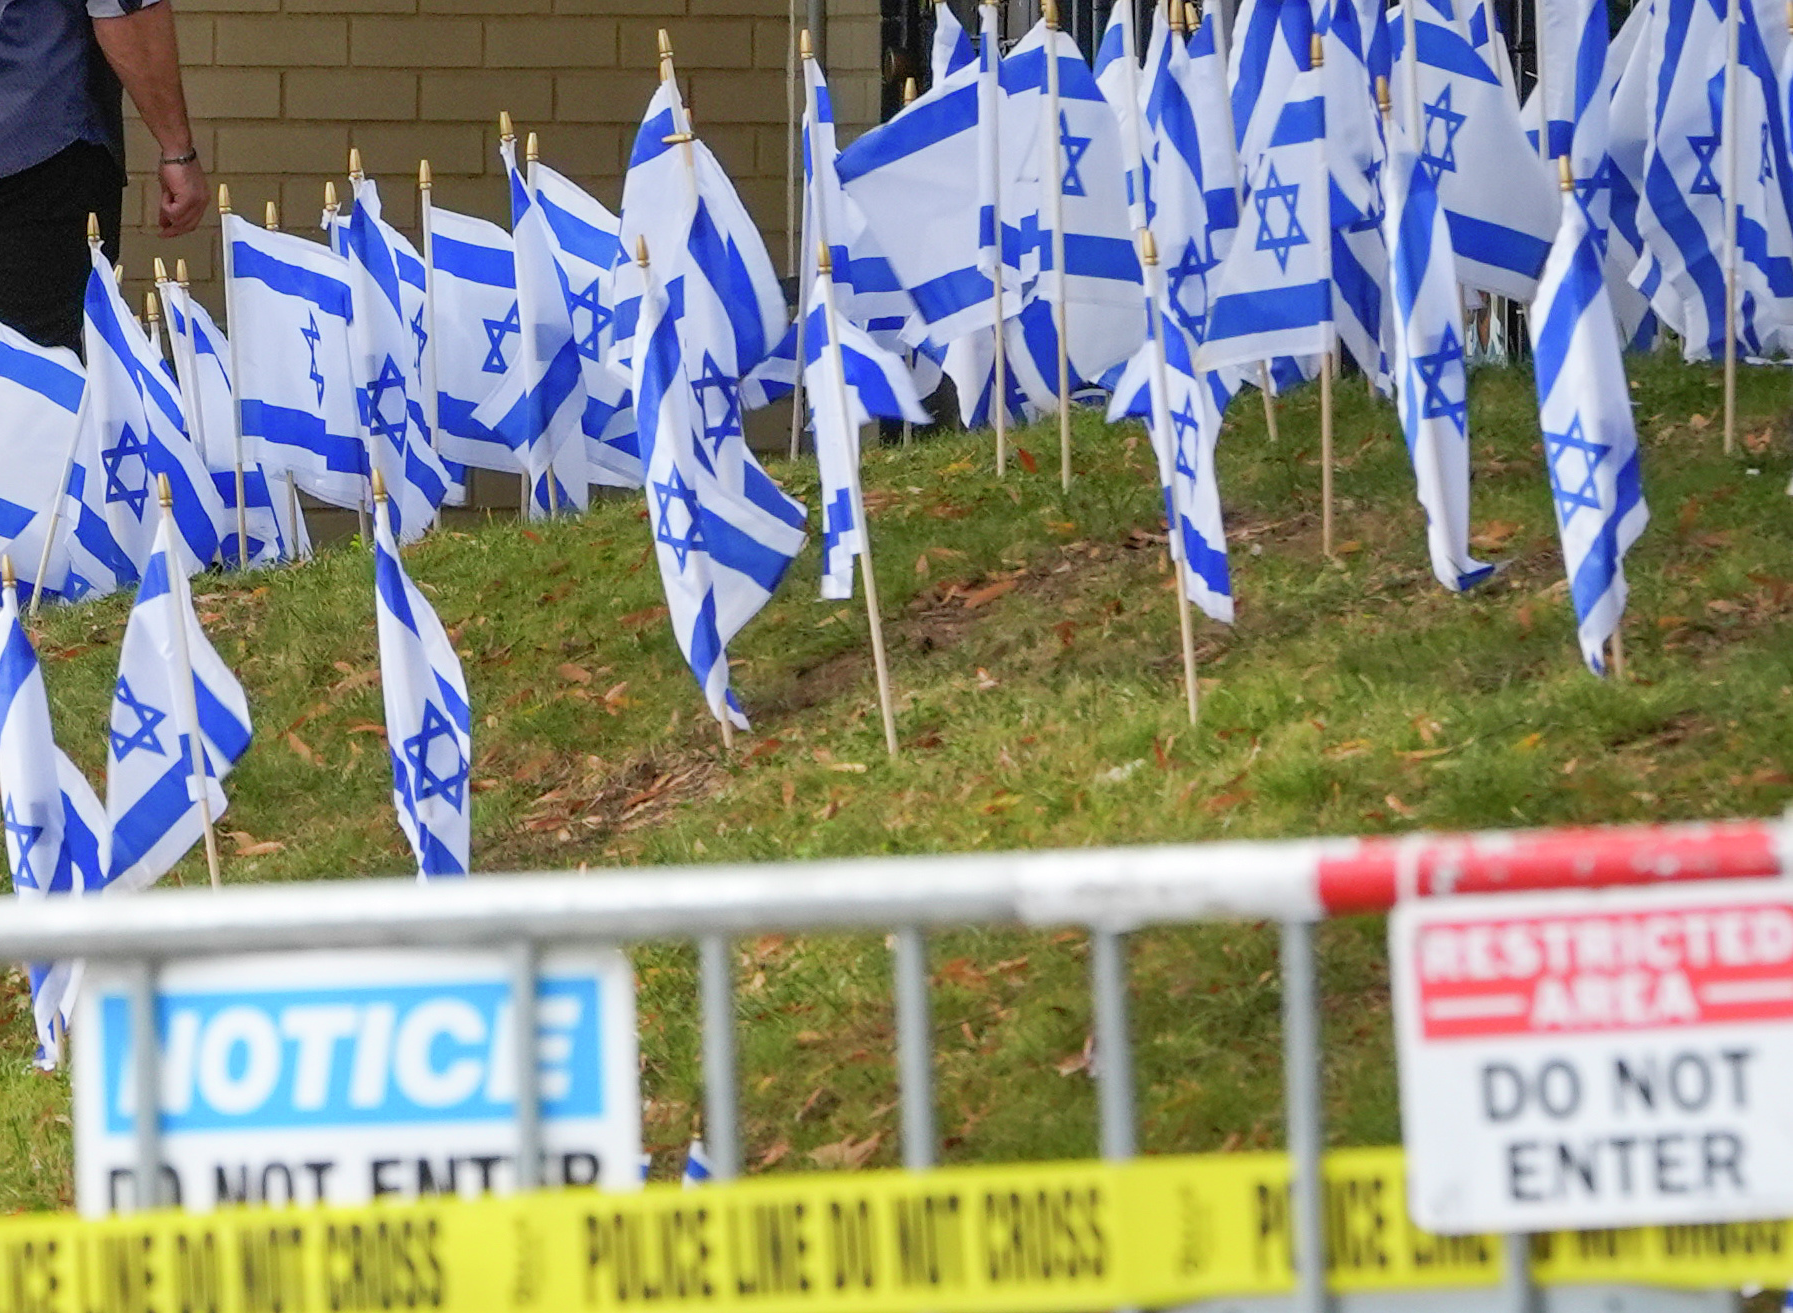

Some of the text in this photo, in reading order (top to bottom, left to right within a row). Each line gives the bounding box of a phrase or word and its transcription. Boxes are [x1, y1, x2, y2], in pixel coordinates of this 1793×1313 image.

[1419, 908, 1793, 984] RESTRICTED
[1530, 967, 1702, 1032] AREA
[116, 994, 585, 1118] NOTICE
[1480, 1046, 1752, 1123] DO NOT
[1506, 1130, 1746, 1202] ENTER
[582, 1205, 712, 1303] POLICE
[724, 1200, 814, 1295] LINE
[826, 1196, 879, 1290] DO
[886, 1191, 965, 1286] NOT
[981, 1186, 1109, 1282] CROSS
